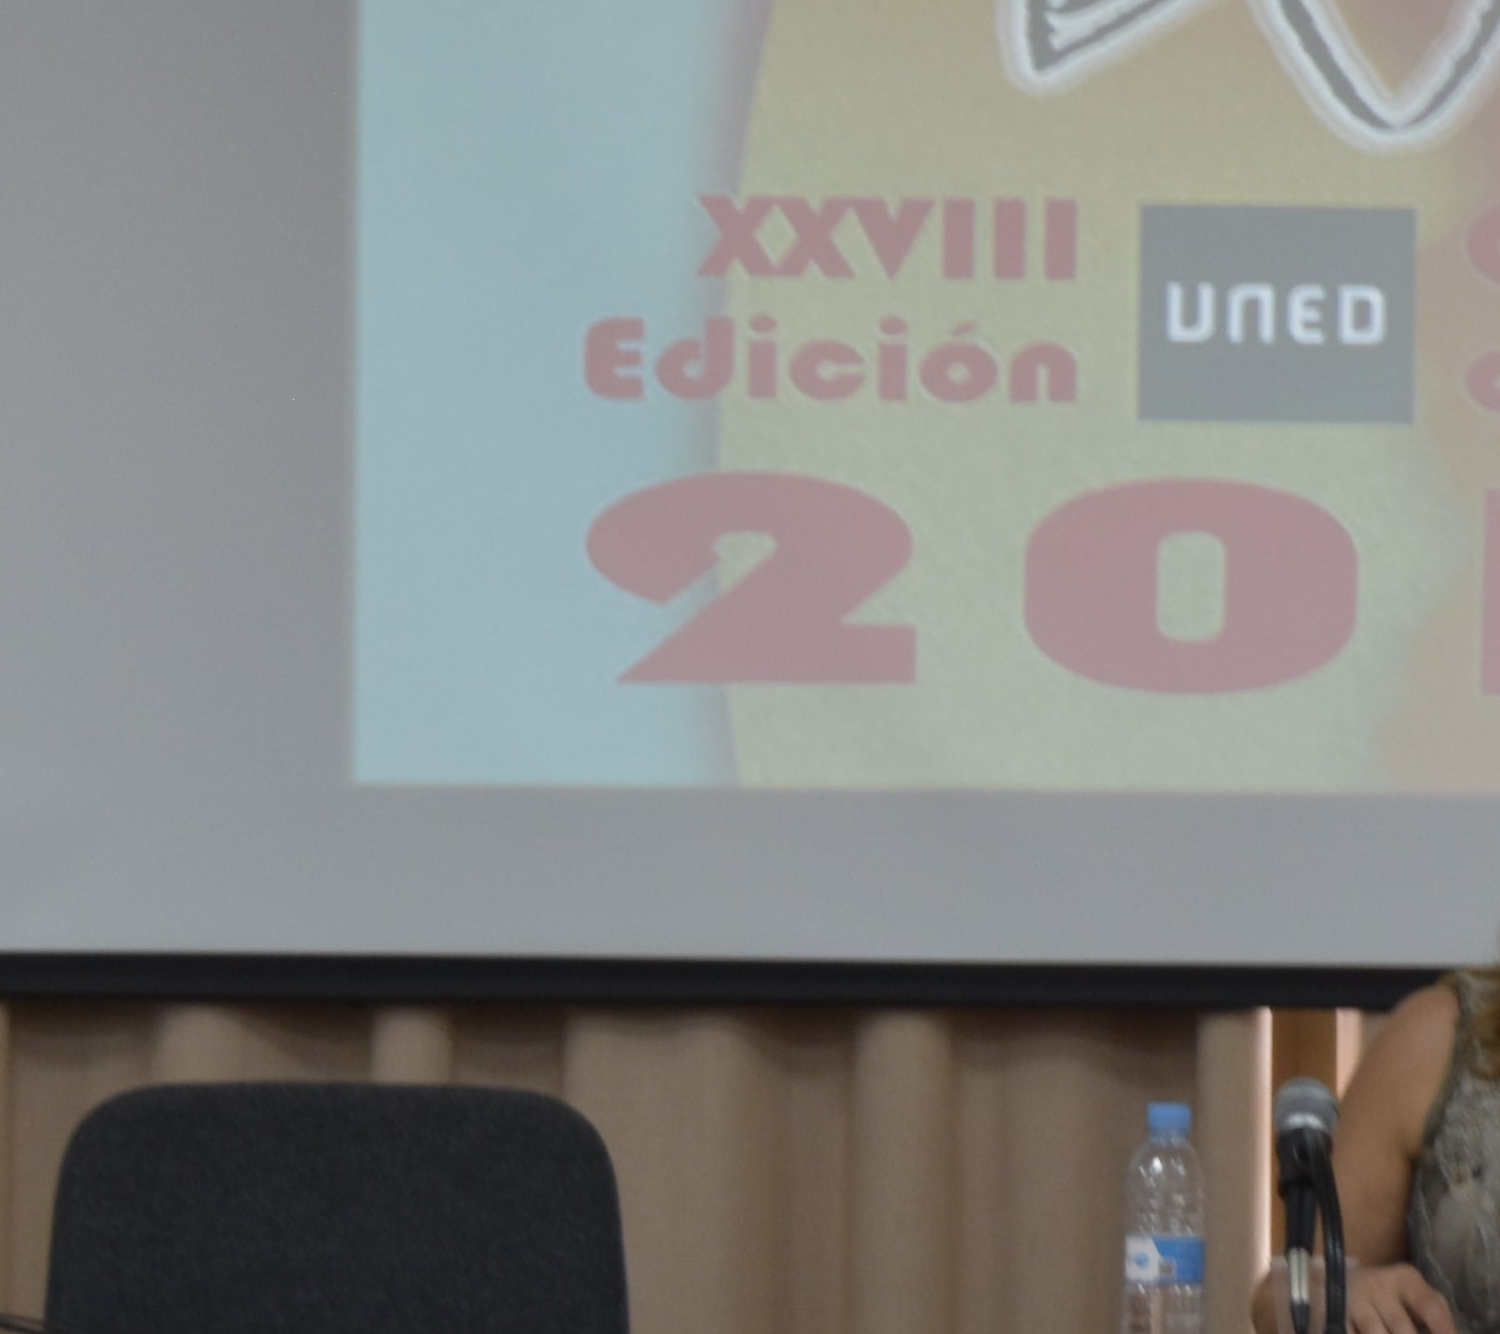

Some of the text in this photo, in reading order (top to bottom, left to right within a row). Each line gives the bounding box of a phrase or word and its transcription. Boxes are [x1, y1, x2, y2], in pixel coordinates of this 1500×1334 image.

[697, 195, 1078, 282] XXVIII
[1165, 281, 1386, 347] UNED
[583, 318, 1078, 404] Edición
